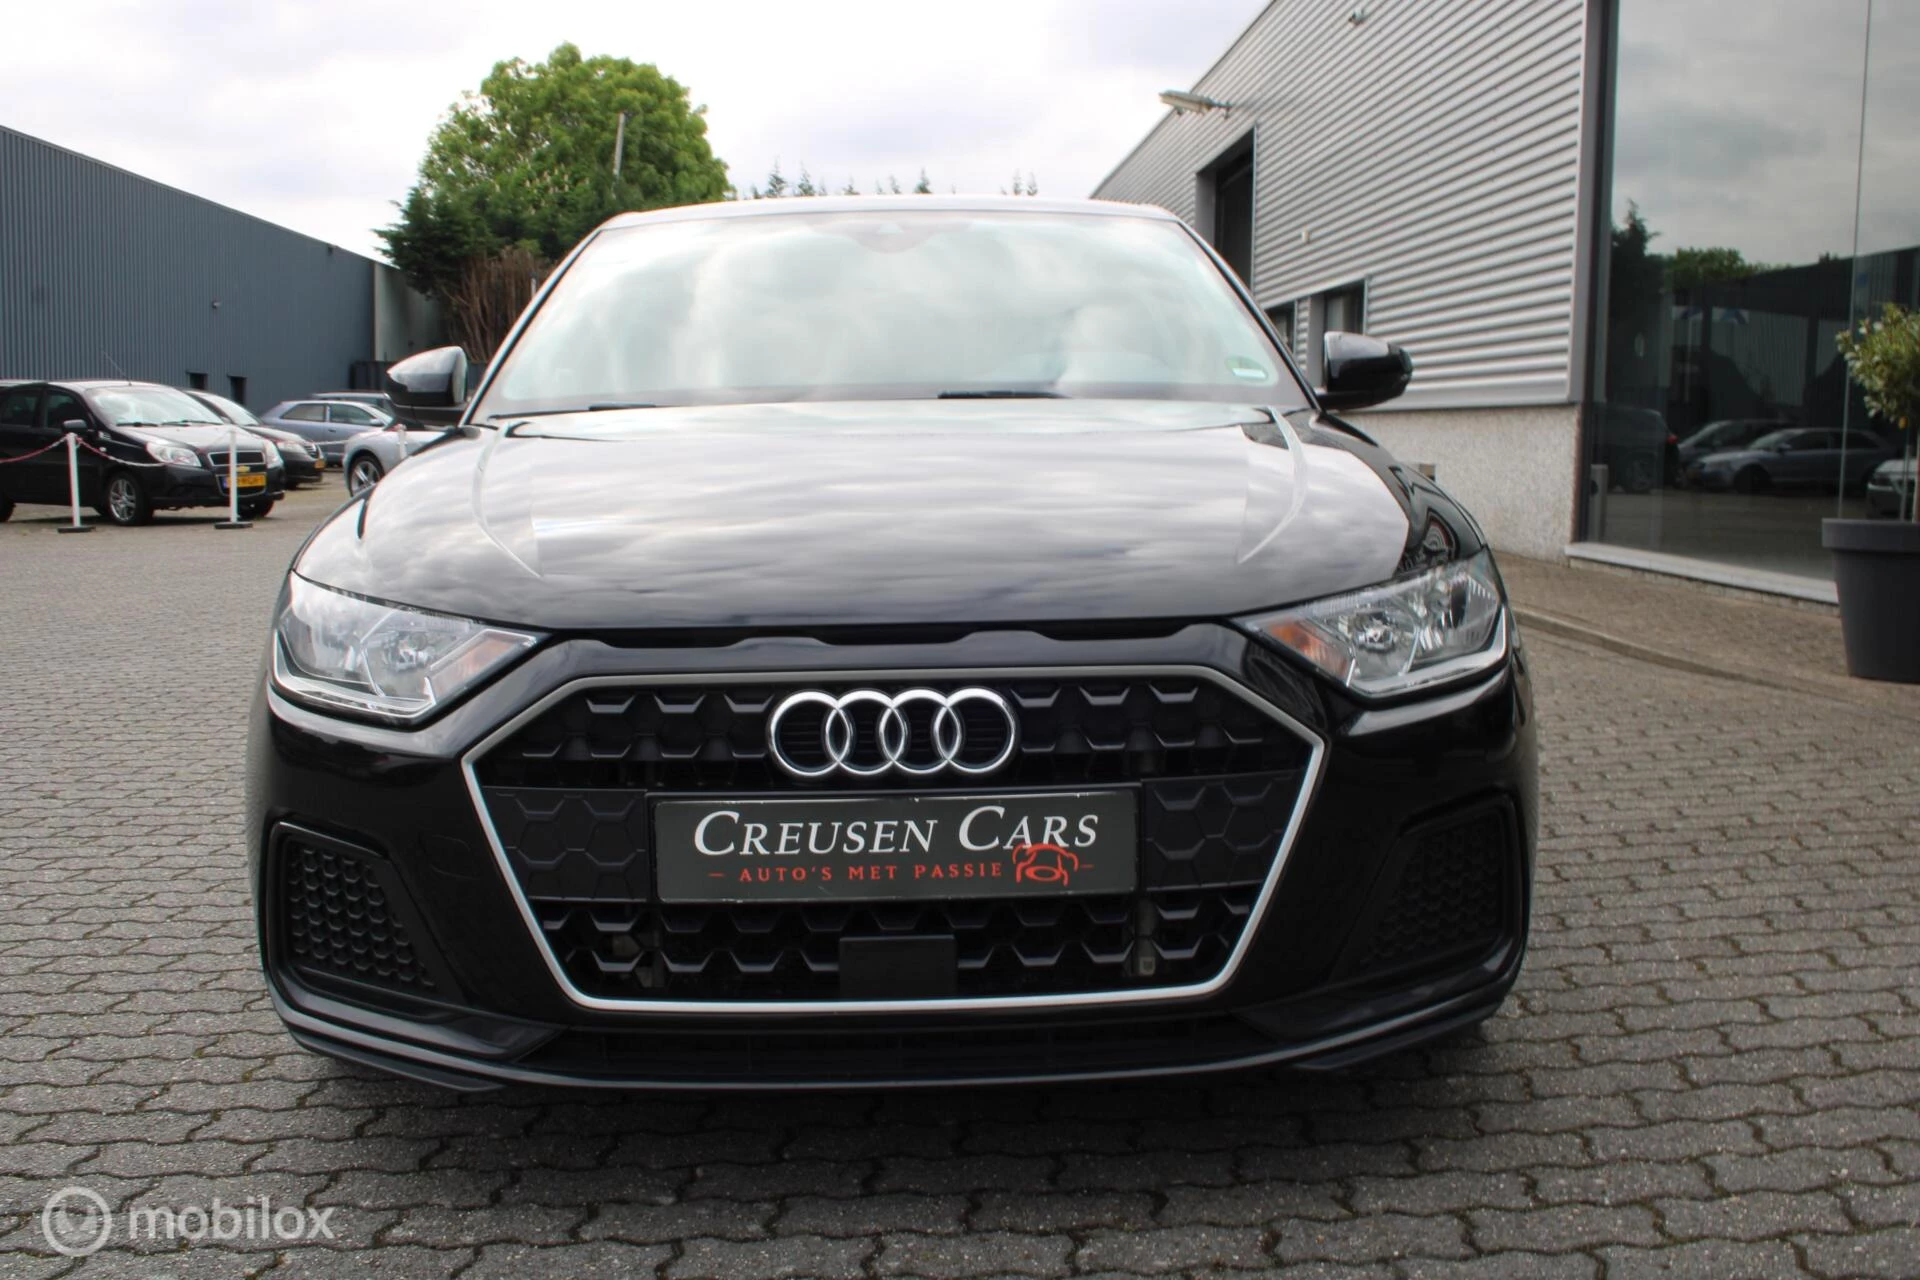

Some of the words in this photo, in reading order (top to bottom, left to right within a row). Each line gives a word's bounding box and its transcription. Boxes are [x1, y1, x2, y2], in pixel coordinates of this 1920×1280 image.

[693, 810, 938, 856] CREUSEN
[958, 805, 1099, 851] CARS
[739, 866, 833, 882] AUTO'S
[847, 865, 897, 881] MET
[914, 862, 1002, 880] PASSIE
